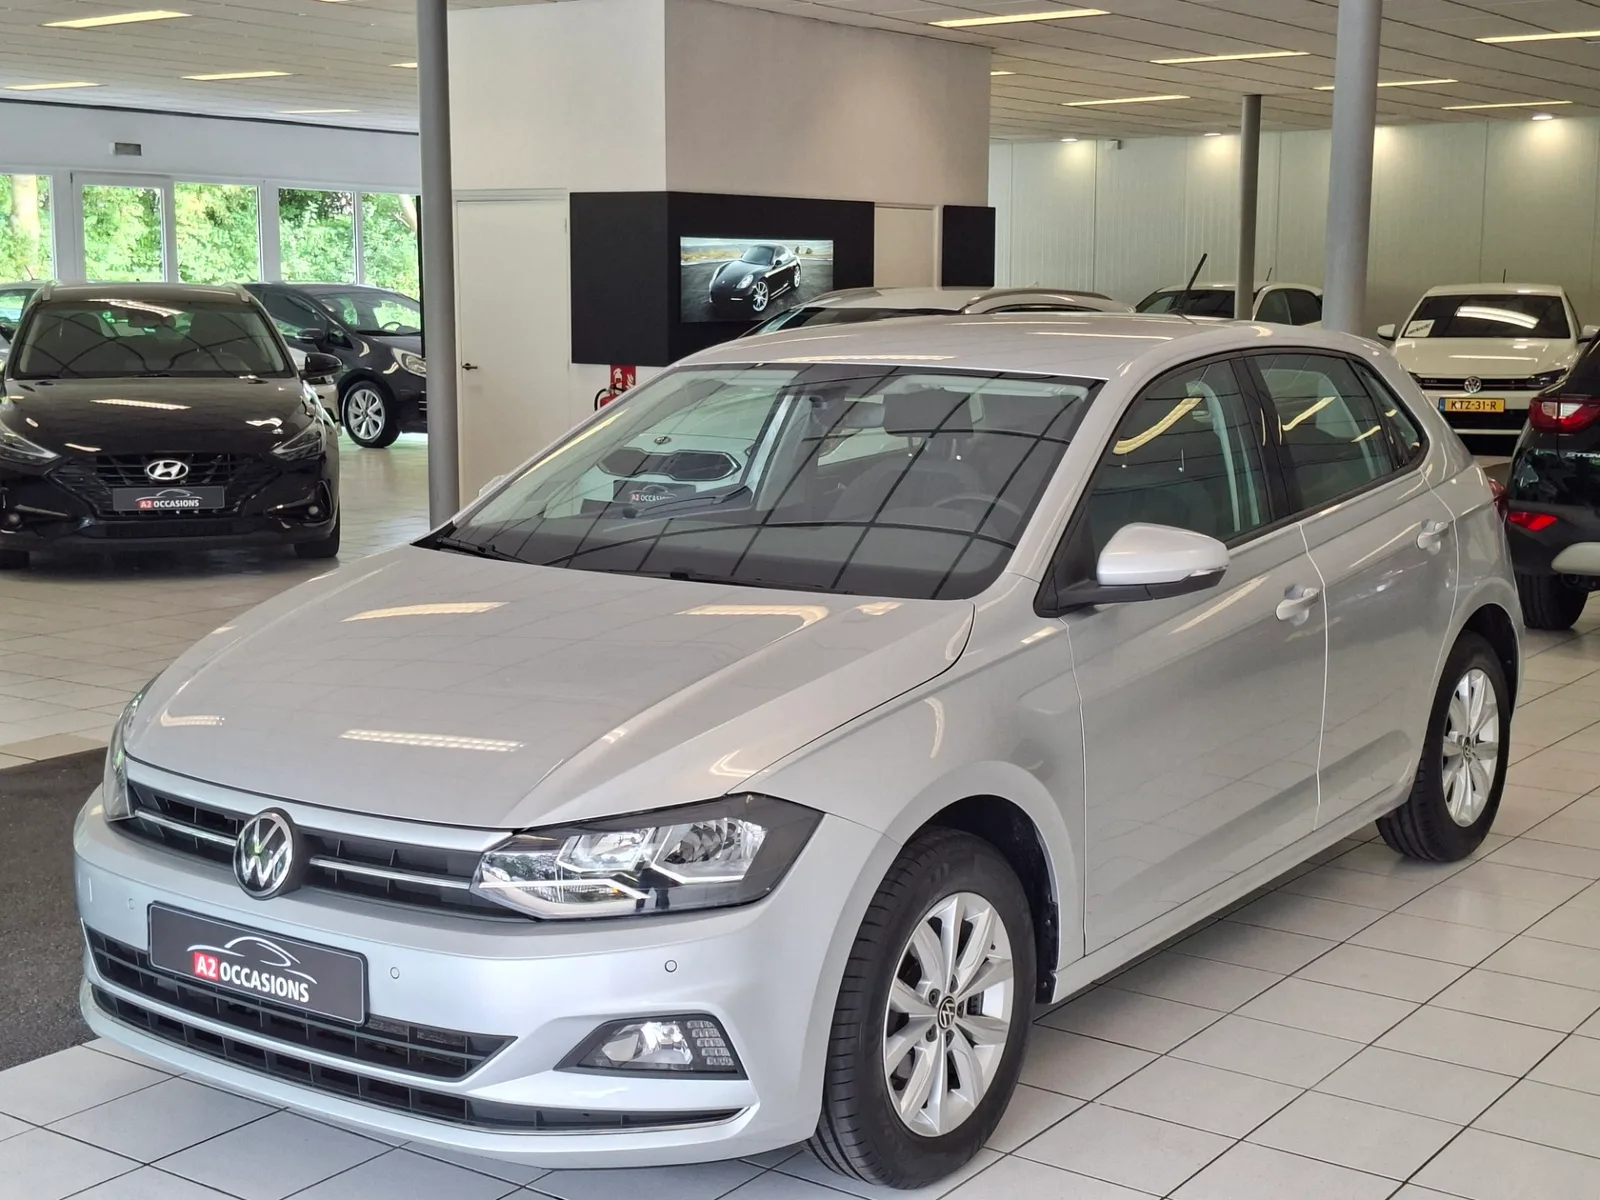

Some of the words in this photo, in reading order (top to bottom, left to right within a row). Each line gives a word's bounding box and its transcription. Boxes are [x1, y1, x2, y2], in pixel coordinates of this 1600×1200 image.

[1451, 400, 1497, 410] KTZ-31-R
[140, 500, 152, 509] A2
[153, 500, 200, 508] OCCASIONS
[196, 955, 218, 978] A2
[219, 961, 310, 1003] OCCASIONS
